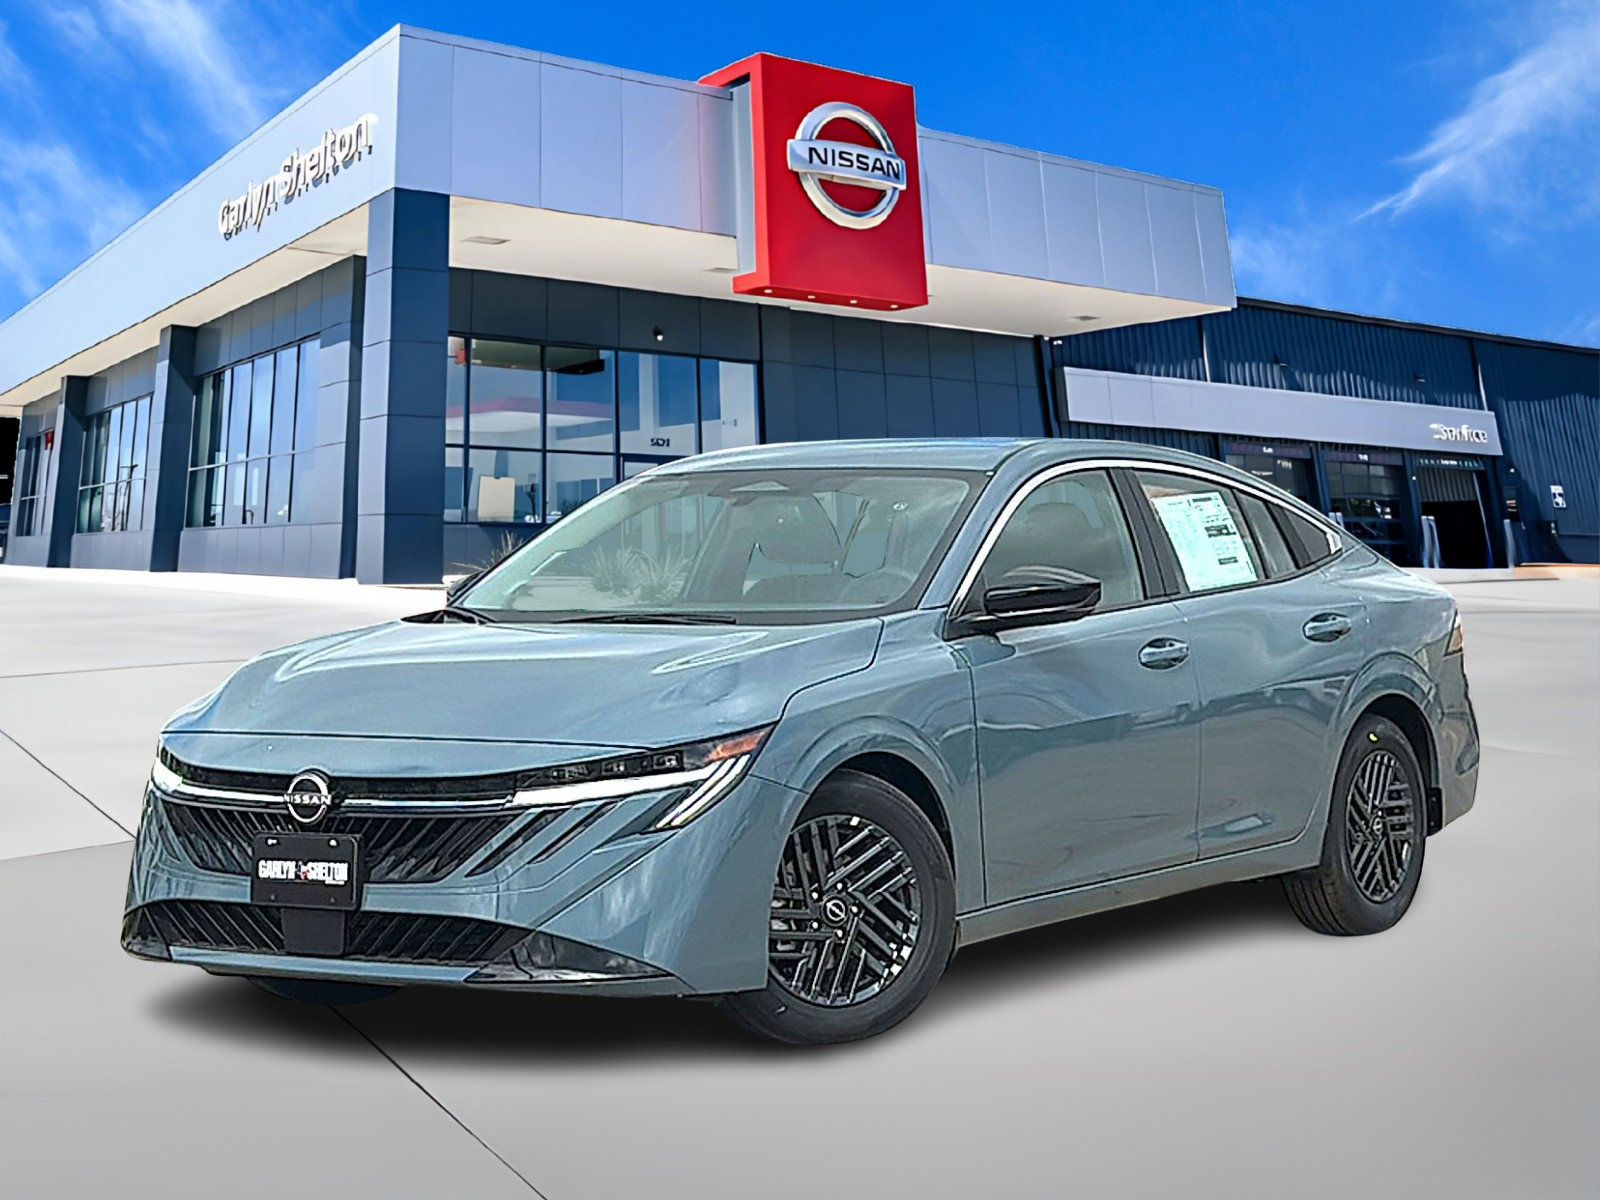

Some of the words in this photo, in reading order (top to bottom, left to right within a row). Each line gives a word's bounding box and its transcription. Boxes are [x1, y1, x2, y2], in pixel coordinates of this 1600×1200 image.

[280, 115, 376, 201] Shelton
[808, 146, 900, 180] NISSAN
[1429, 423, 1488, 443] Service
[284, 793, 332, 805] NISSAN
[258, 859, 296, 879] GARLYN
[306, 861, 348, 881] SHELTON
